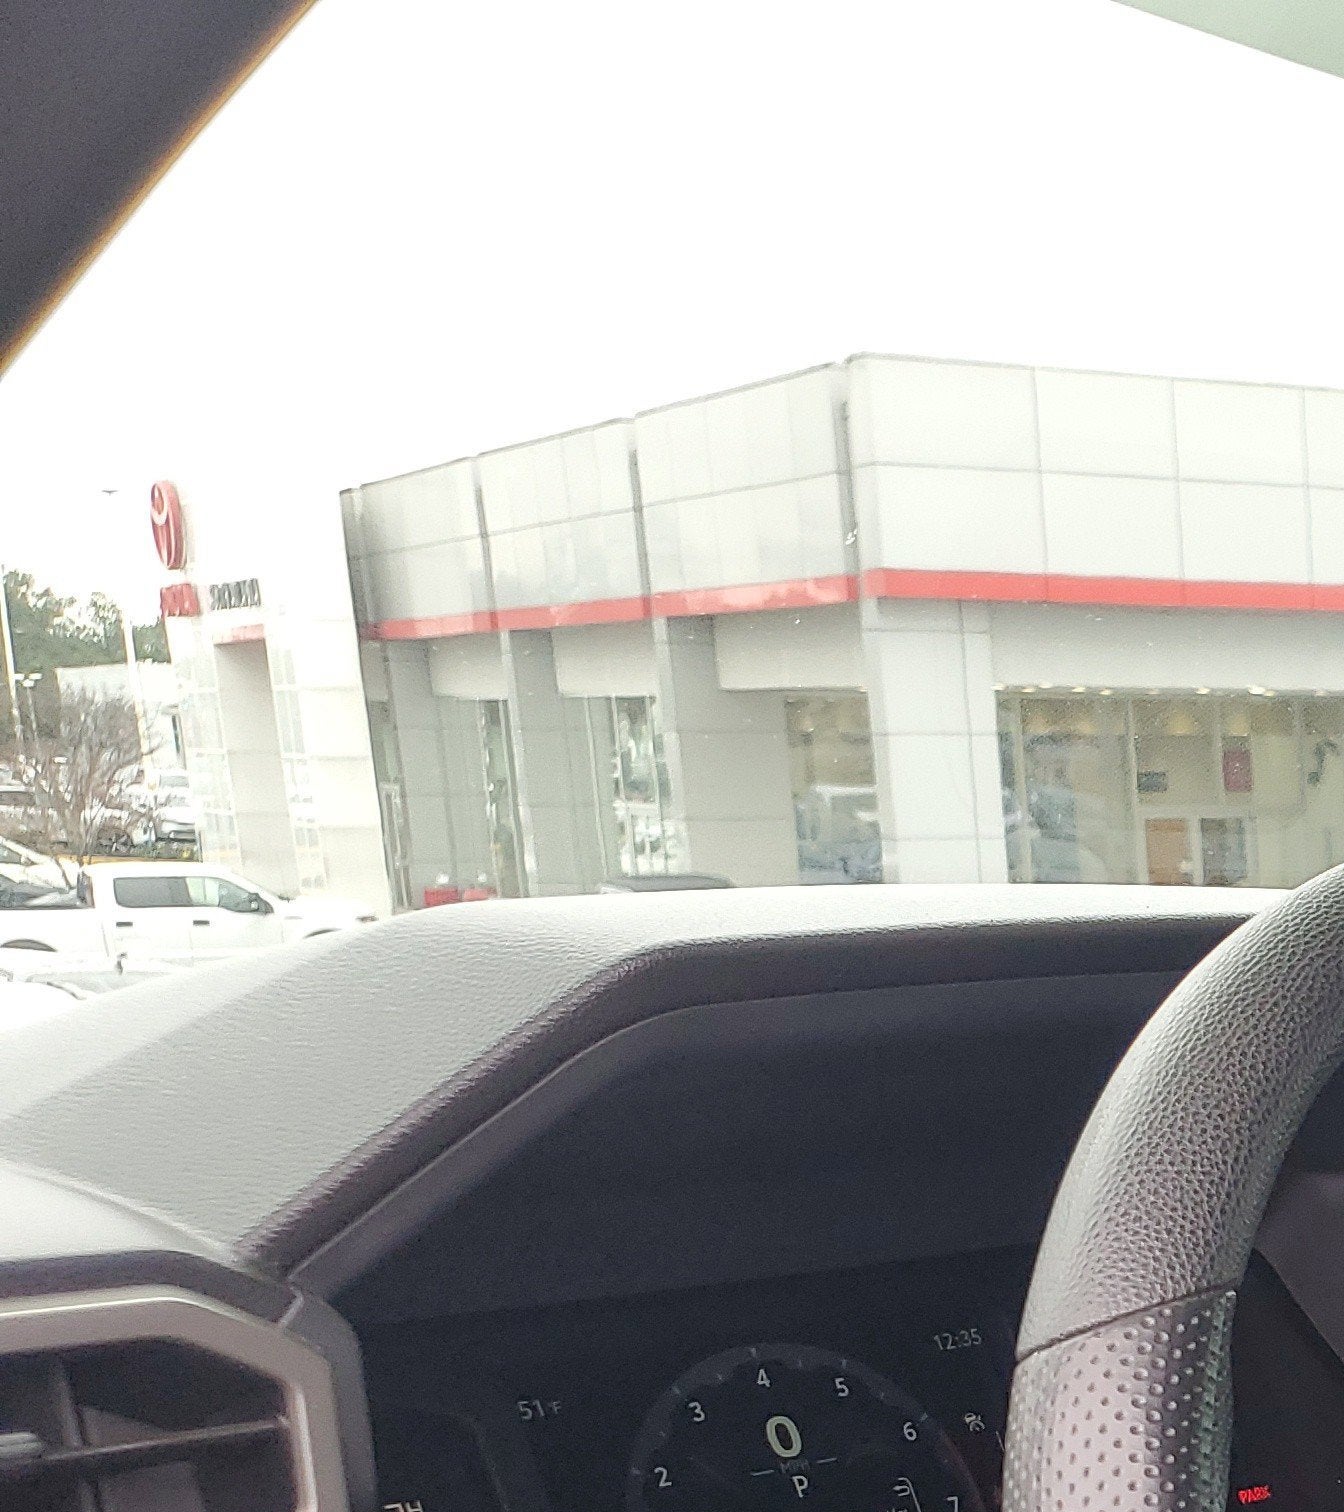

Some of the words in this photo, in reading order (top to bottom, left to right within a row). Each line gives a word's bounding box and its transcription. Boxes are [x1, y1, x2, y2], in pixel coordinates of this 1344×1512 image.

[934, 1327, 982, 1352] 12:35
[757, 1370, 771, 1390] 4
[836, 1377, 848, 1397] 5
[690, 1401, 705, 1422] 3
[766, 1415, 802, 1458] 0
[903, 1421, 917, 1442] 6
[655, 1467, 672, 1488] 2
[791, 1475, 809, 1498] P
